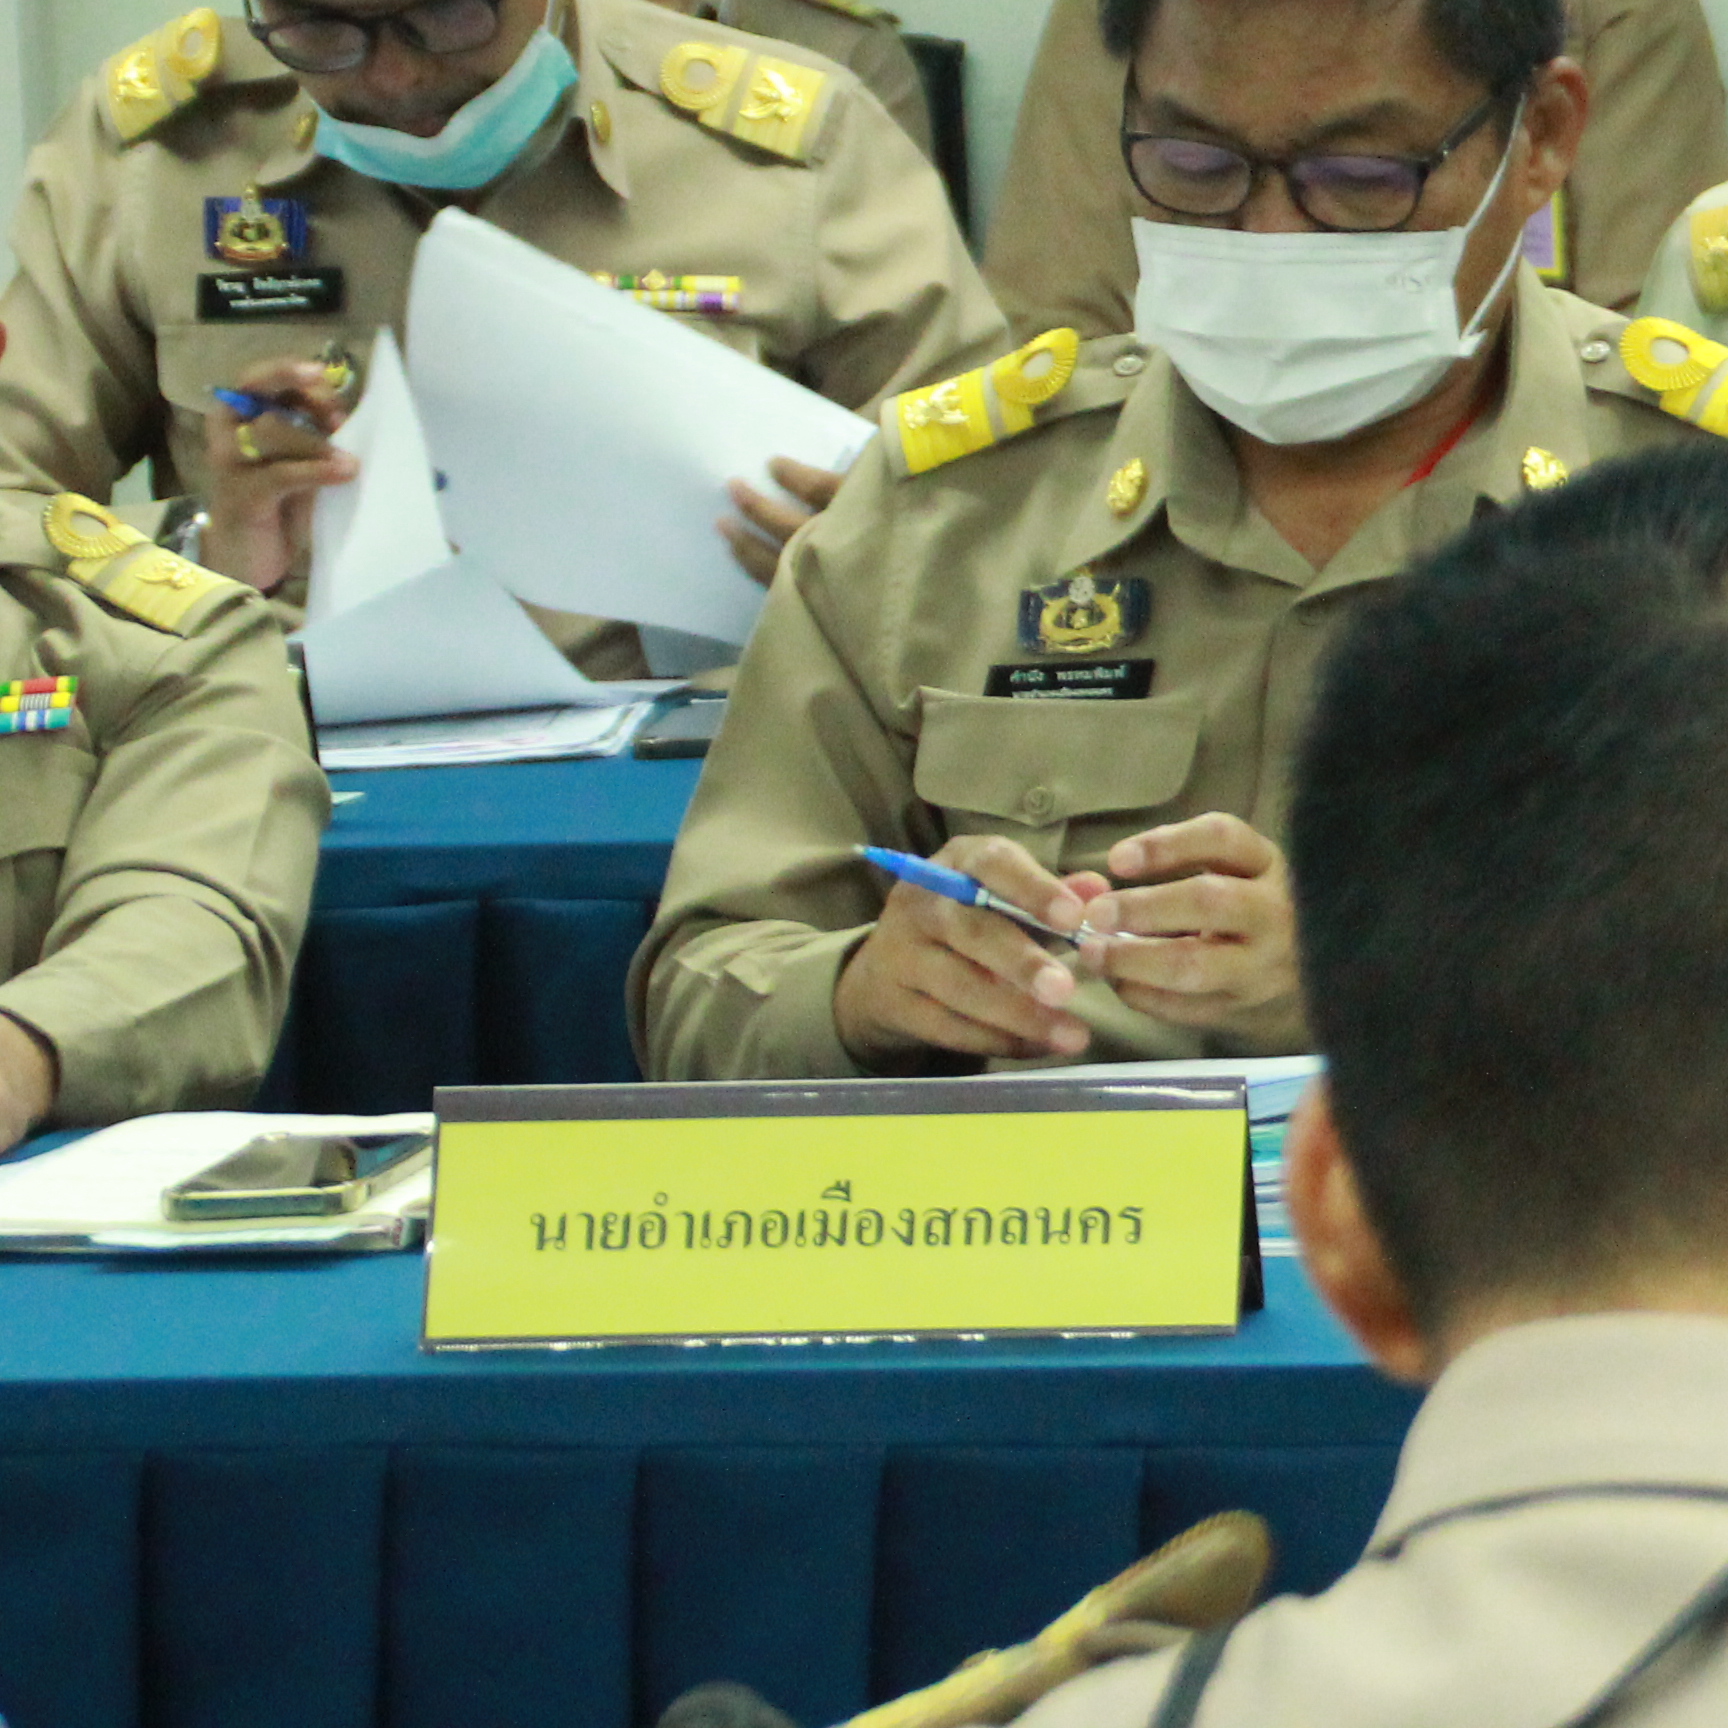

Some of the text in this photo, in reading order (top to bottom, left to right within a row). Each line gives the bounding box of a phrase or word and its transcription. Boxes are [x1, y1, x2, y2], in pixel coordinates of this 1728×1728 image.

[529, 1179, 1146, 1252] นายอำเภอเมืองสกลนคร
